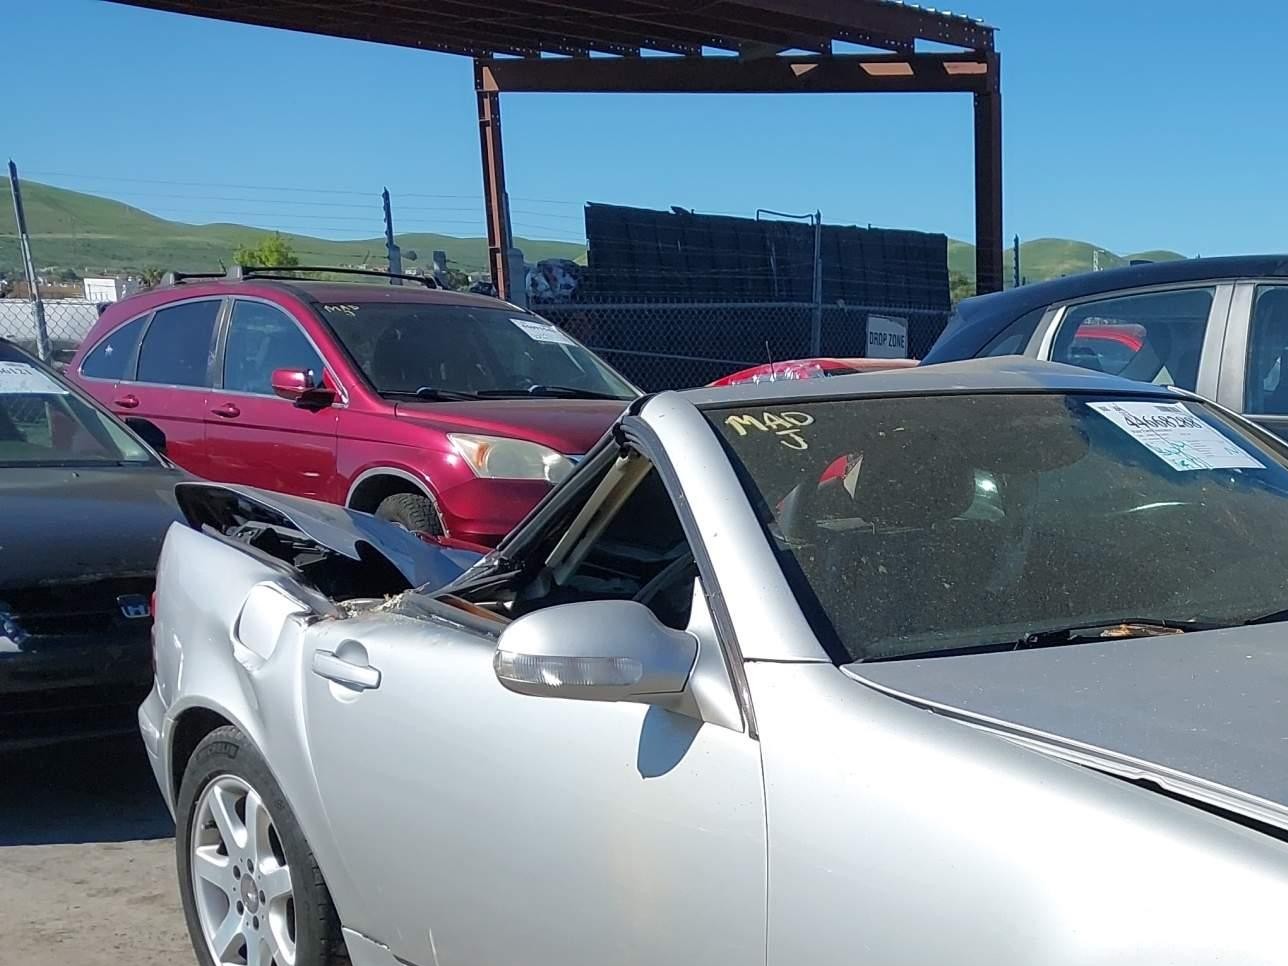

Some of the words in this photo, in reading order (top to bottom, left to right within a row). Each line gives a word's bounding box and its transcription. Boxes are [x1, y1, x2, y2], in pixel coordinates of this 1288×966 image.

[869, 331, 887, 346] DROP
[888, 333, 905, 349] ZONE
[724, 411, 815, 436] MAD
[1123, 415, 1203, 429] 44668288
[775, 428, 809, 450] J
